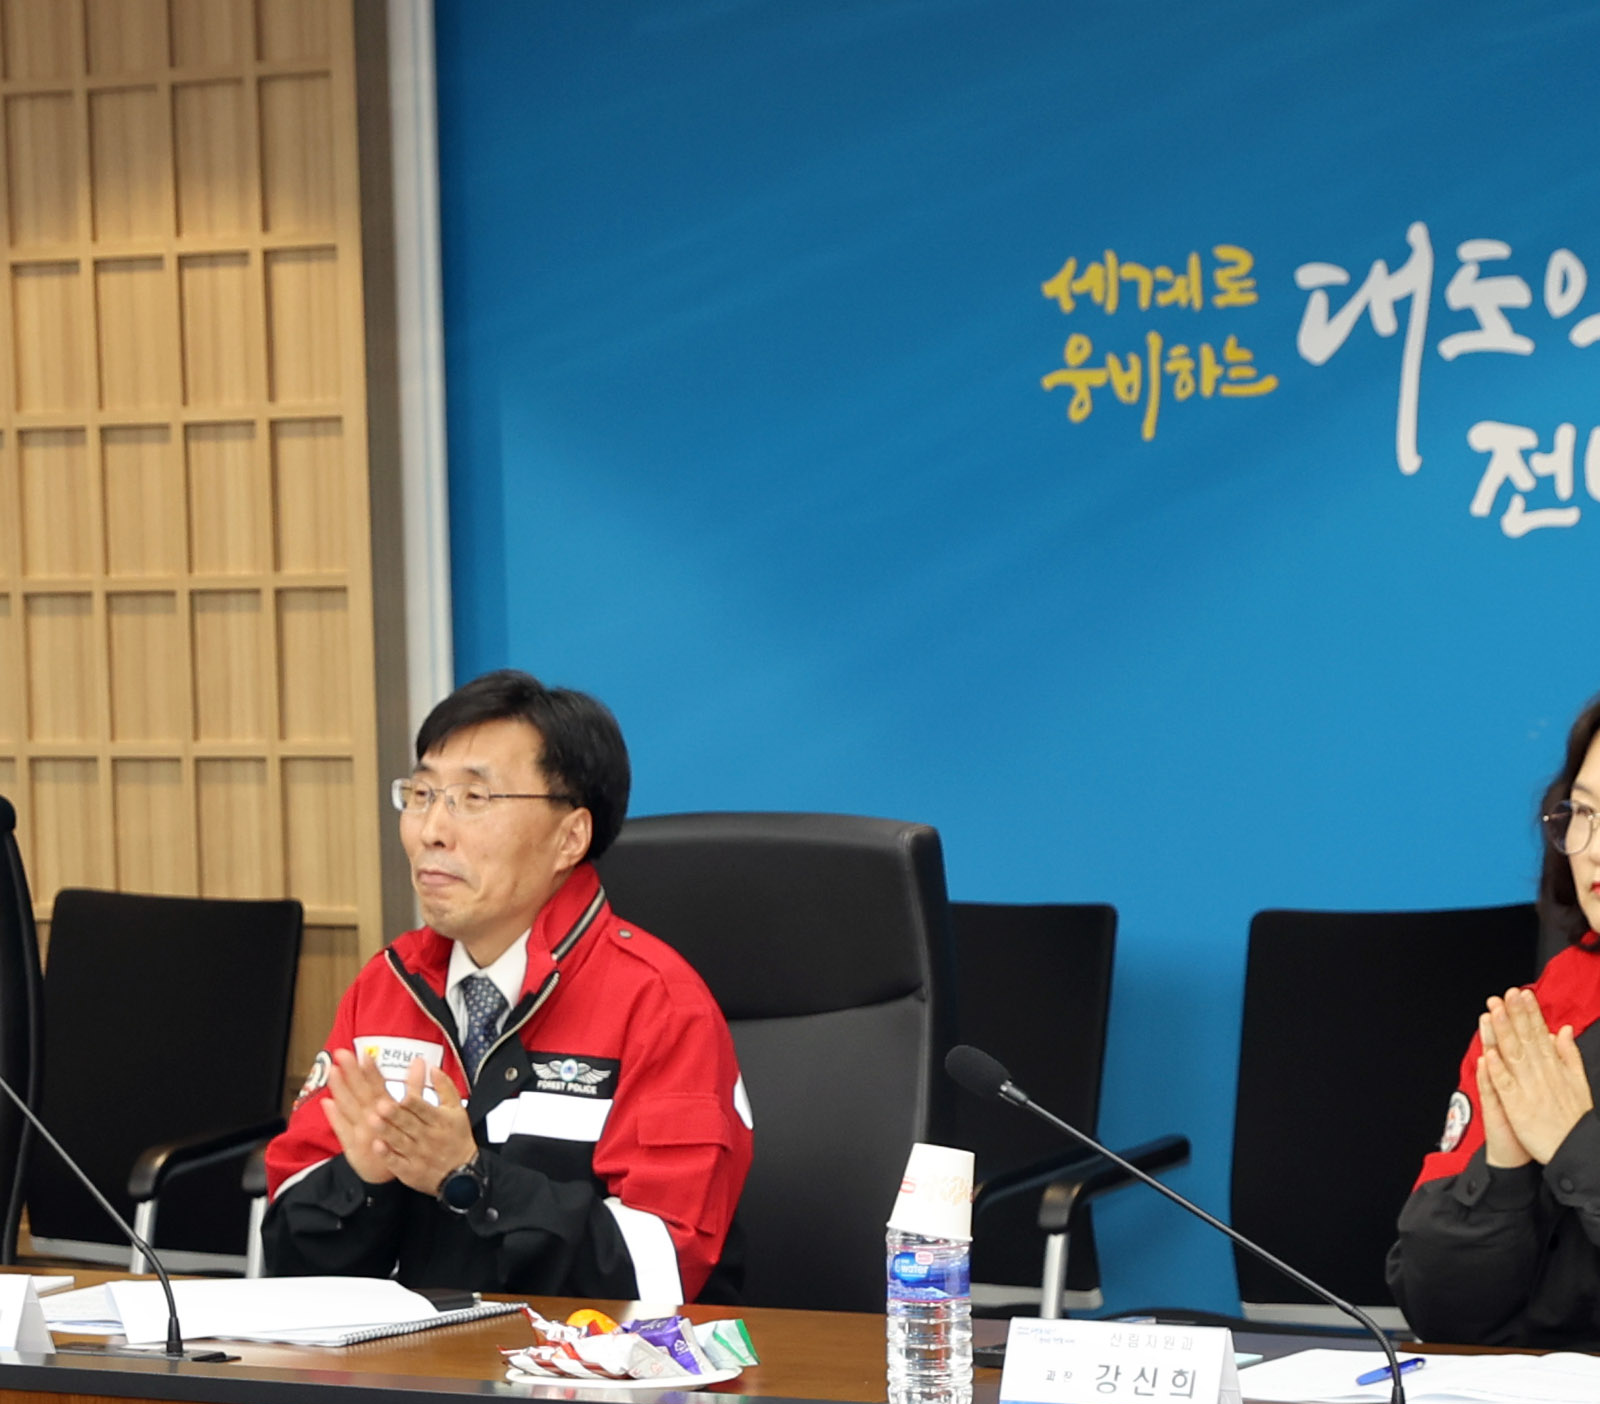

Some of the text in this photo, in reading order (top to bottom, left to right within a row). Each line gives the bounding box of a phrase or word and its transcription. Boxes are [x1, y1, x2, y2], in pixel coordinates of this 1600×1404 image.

[1042, 244, 1258, 314] 세계로
[1041, 331, 1279, 442] 웅비하는
[536, 1079, 597, 1095] FOREST POLICE
[1095, 1364, 1197, 1400] 강신희
